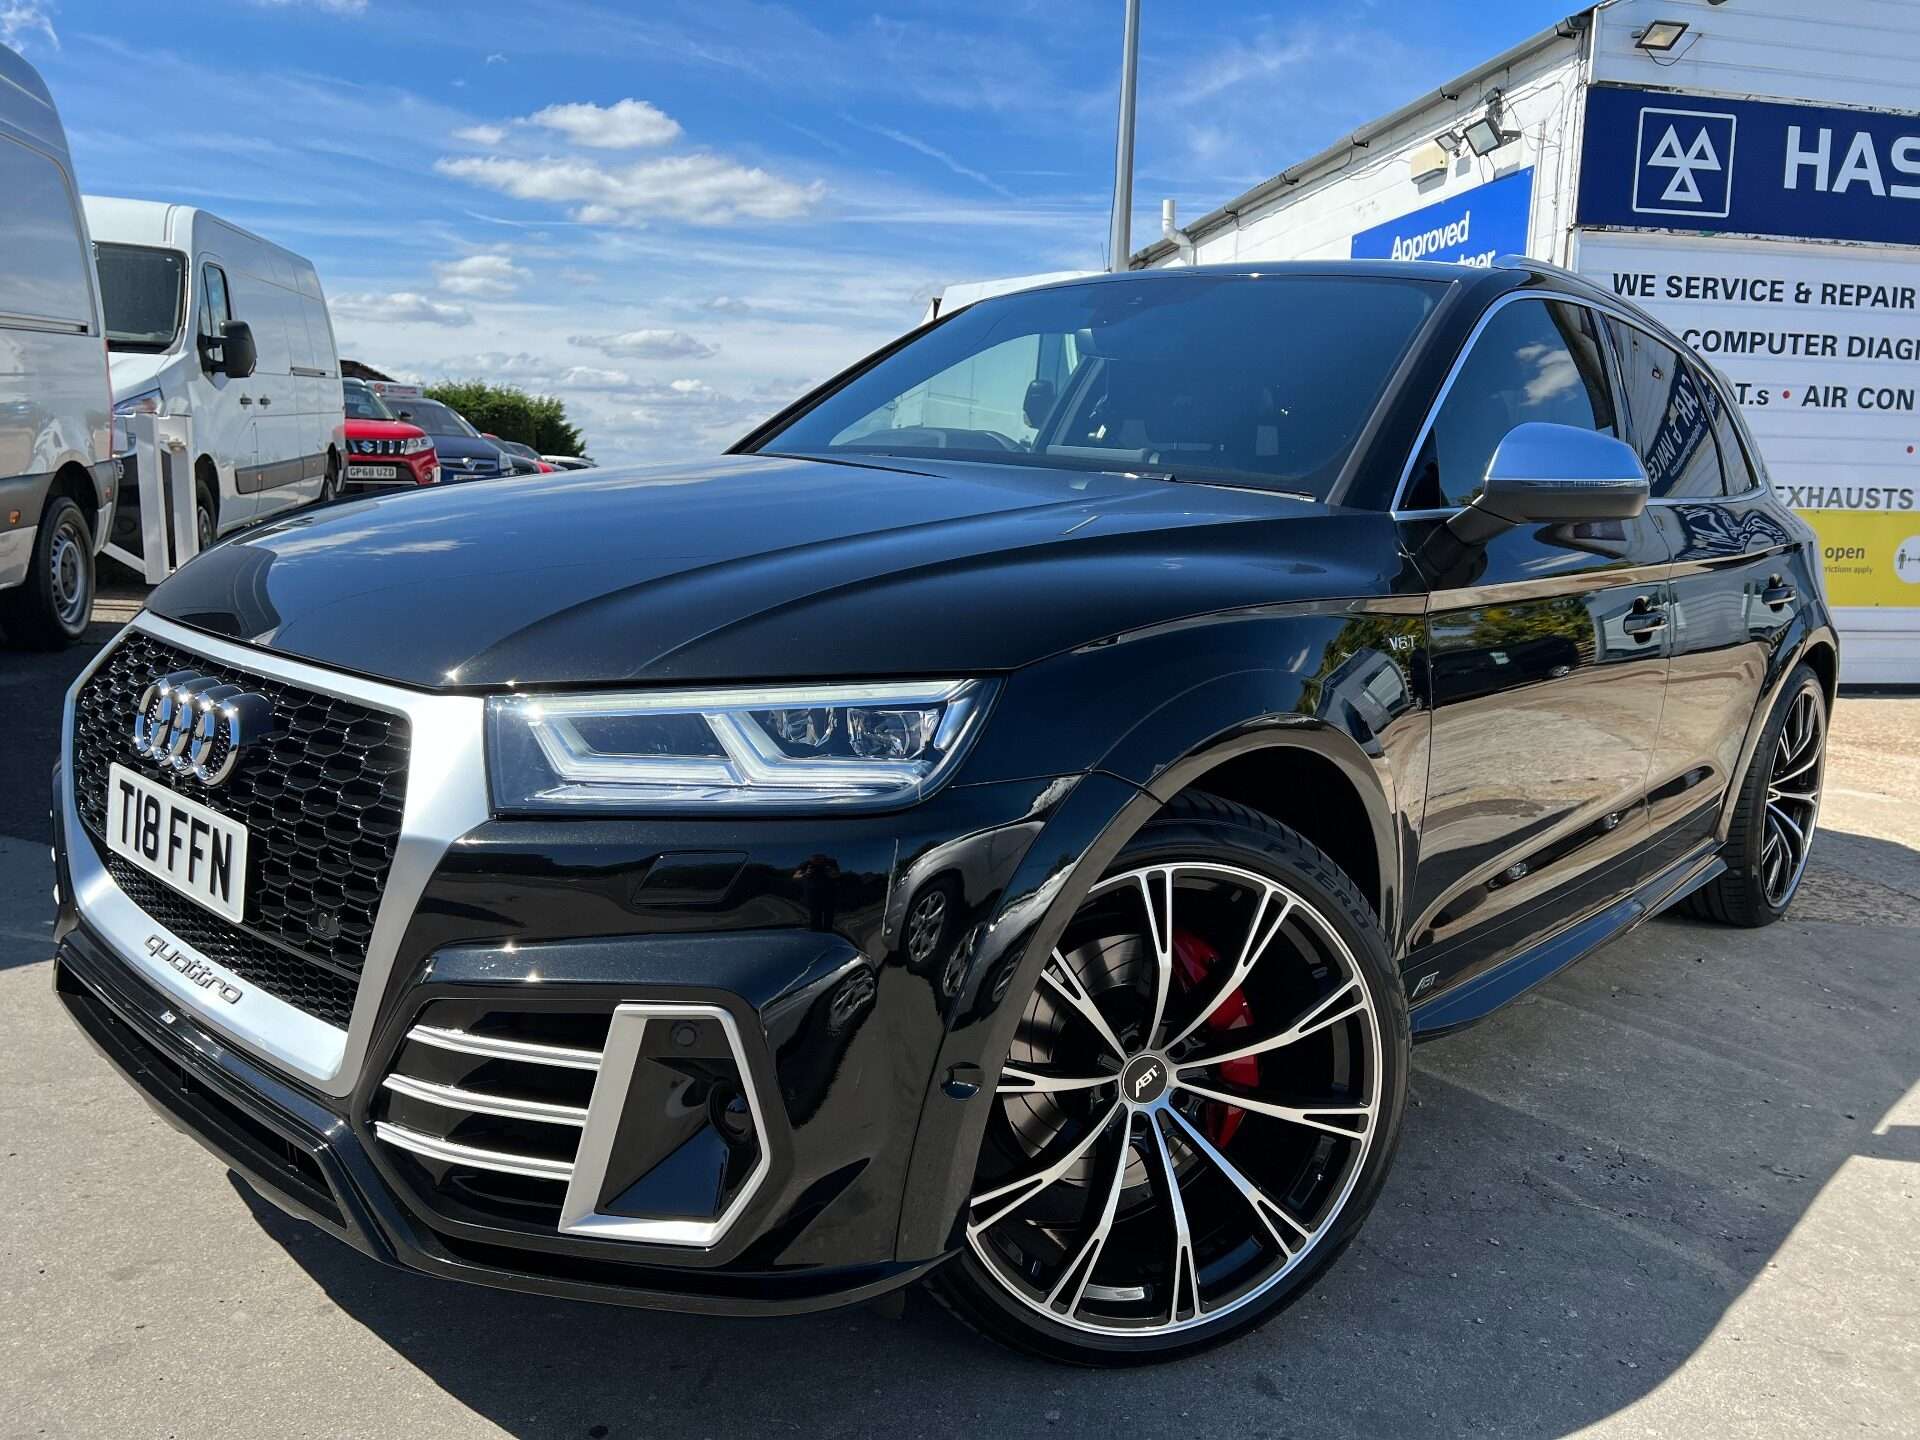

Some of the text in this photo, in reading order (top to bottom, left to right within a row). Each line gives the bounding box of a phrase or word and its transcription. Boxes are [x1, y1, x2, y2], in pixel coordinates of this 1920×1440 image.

[1391, 210, 1470, 261] Approved
[1613, 273, 1916, 309] WE SERVICE & REPAIR
[1682, 329, 1920, 360] COMPUTER DIAG
[1801, 385, 1849, 408] AIR
[1857, 387, 1915, 411] CON
[1824, 546, 1865, 562] open
[119, 779, 232, 904] T18 FFN
[144, 934, 243, 1004] quattro
[1135, 1064, 1160, 1098] ABT
